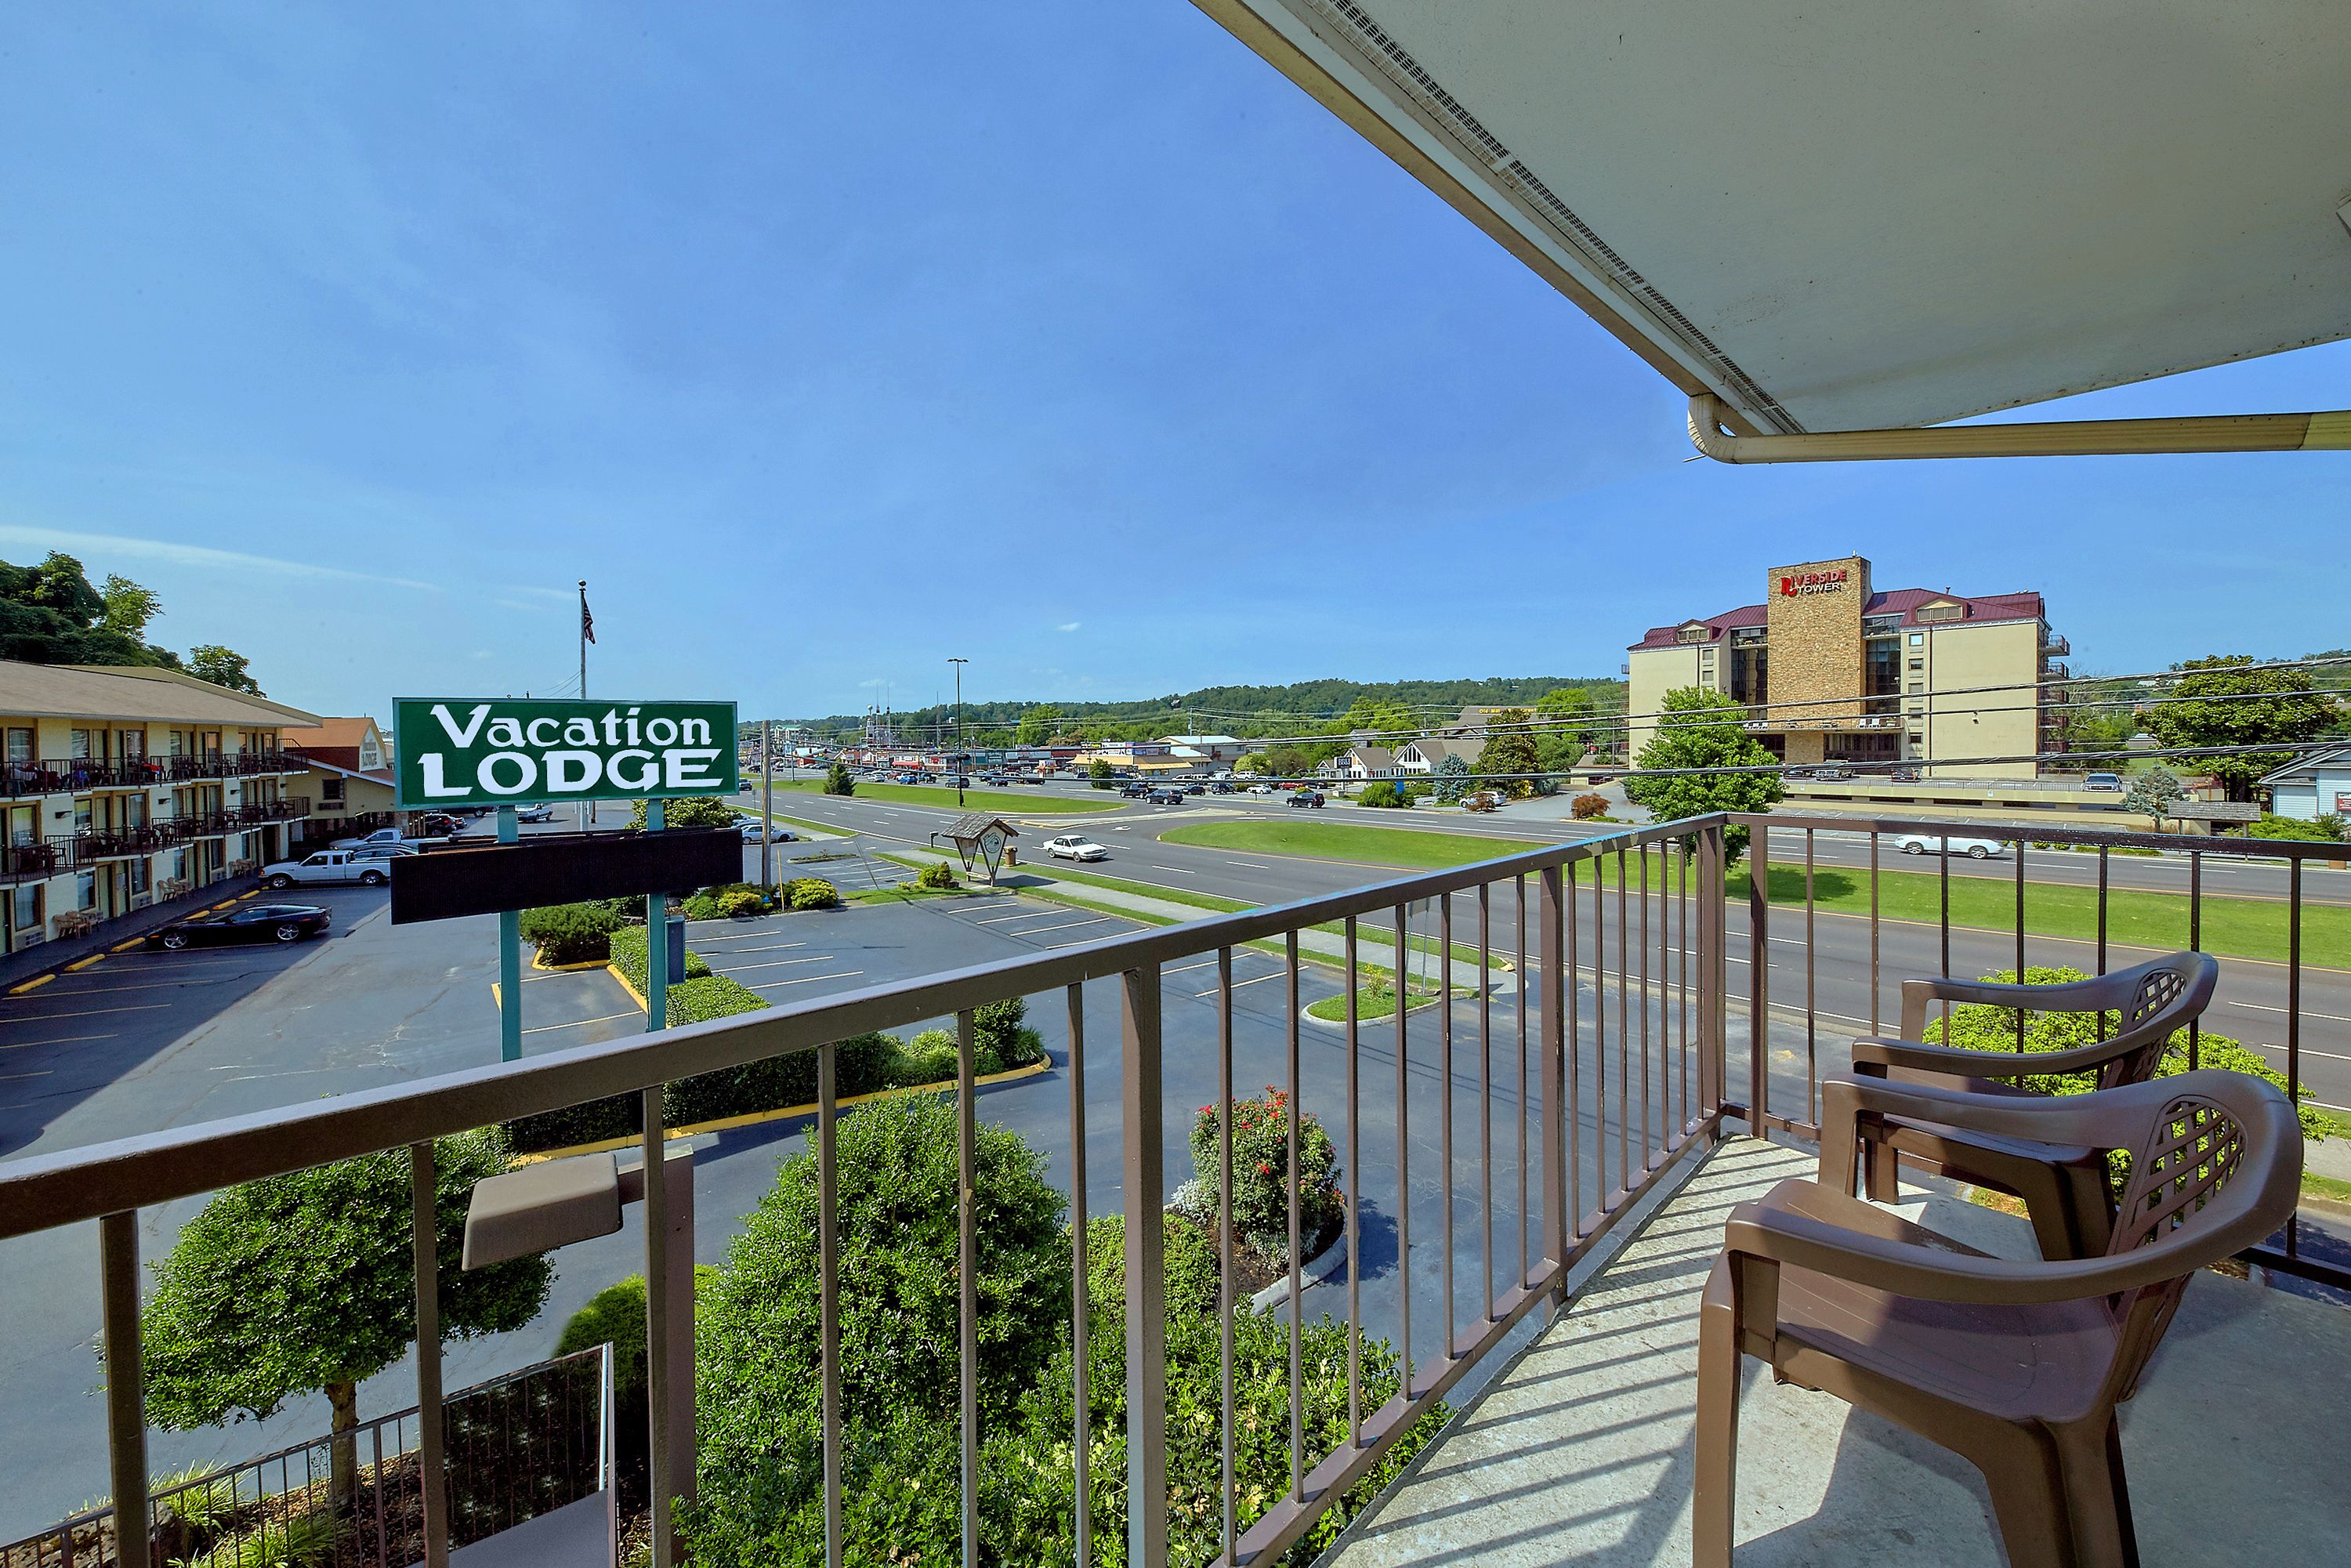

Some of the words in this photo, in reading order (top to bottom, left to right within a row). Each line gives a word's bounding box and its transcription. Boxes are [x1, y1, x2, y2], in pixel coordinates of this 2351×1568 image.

[1780, 570, 1847, 596] RIVERSIDE
[1798, 582, 1841, 593] TOWER
[429, 703, 713, 748] Vacation
[418, 748, 723, 798] LODGE
